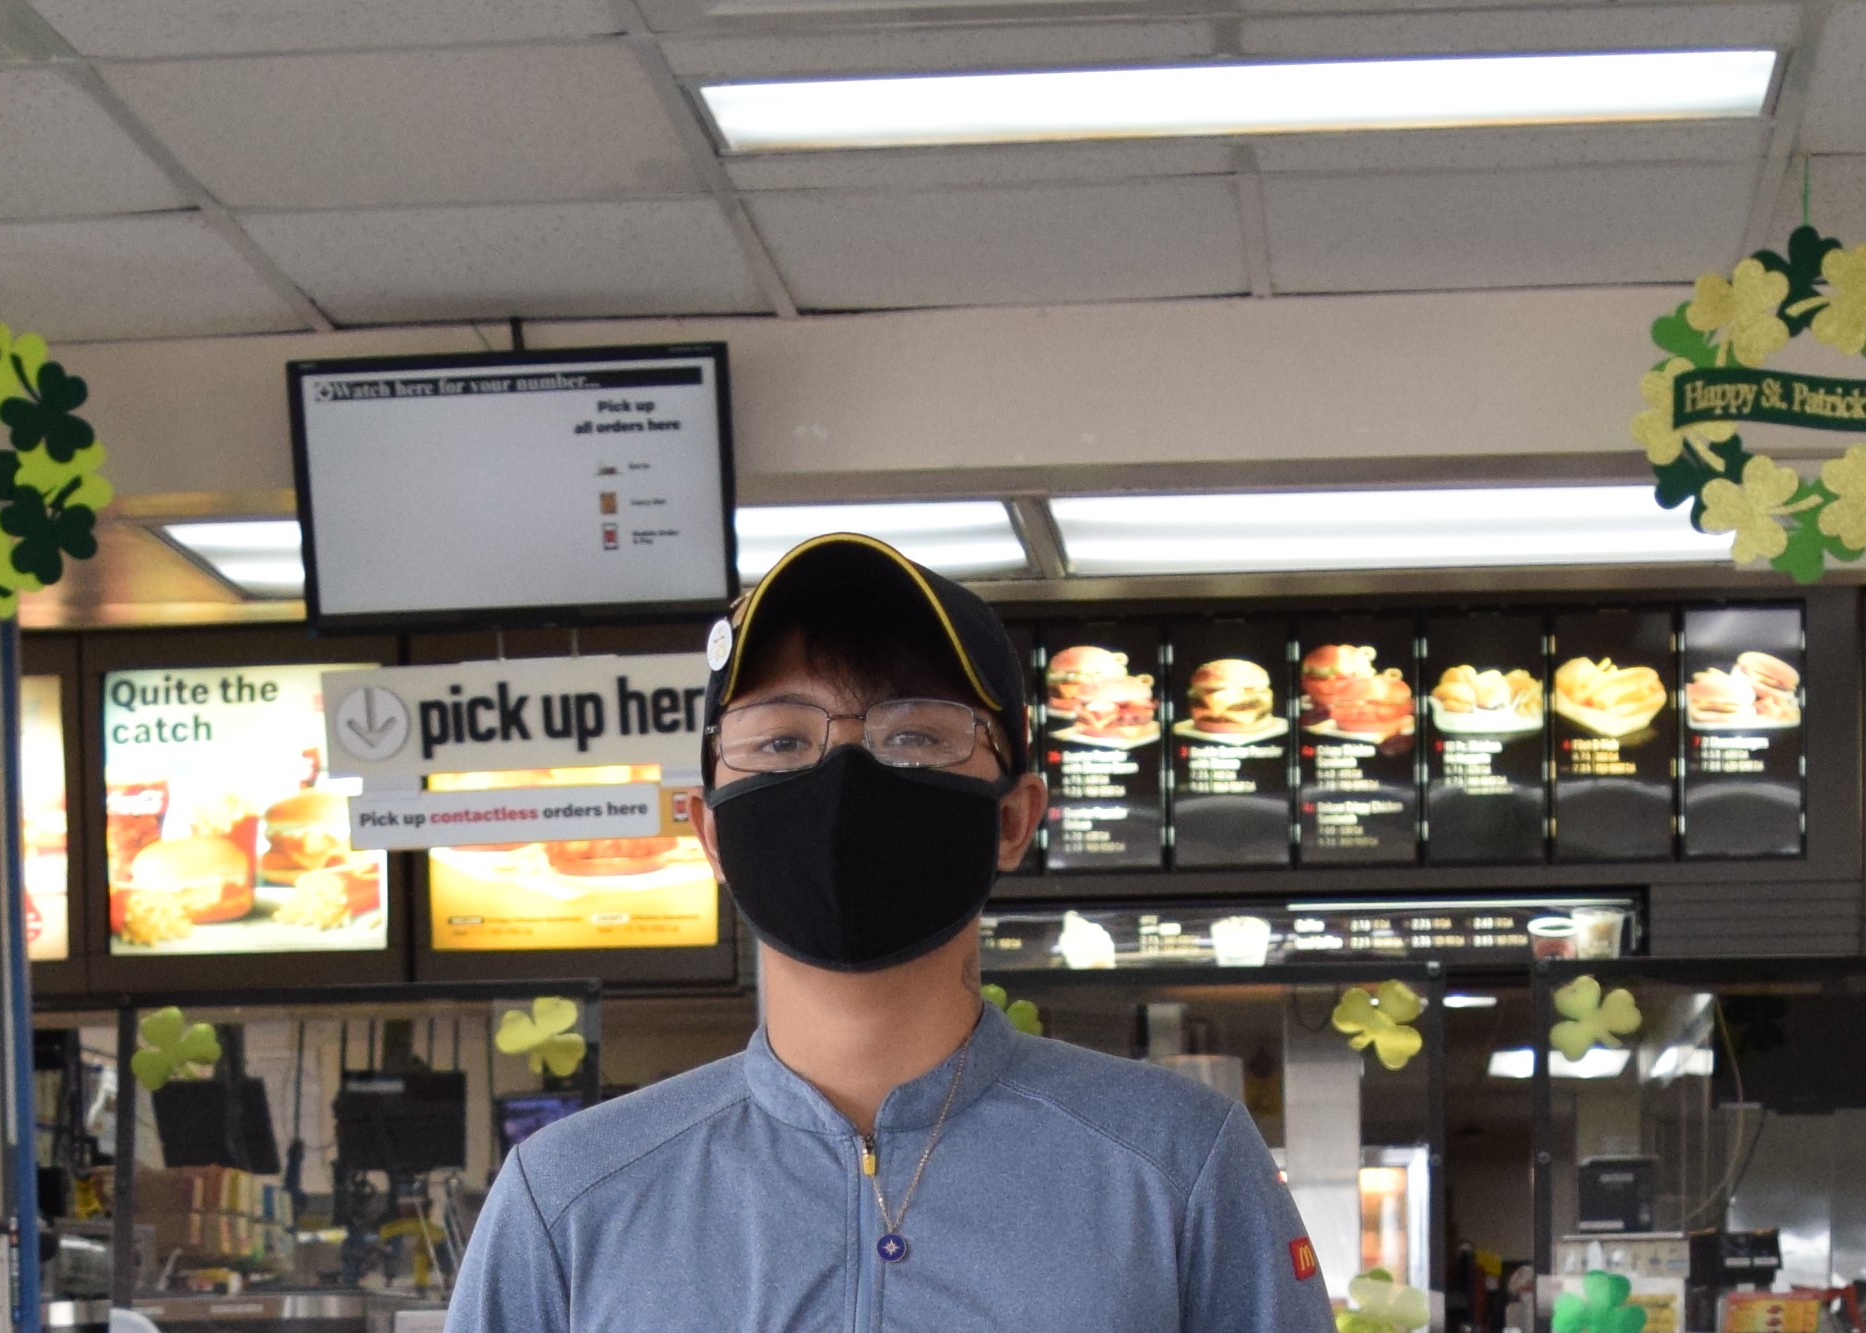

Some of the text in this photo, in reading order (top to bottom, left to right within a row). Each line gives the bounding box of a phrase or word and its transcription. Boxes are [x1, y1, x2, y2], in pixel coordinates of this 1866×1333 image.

[333, 372, 600, 399] Watch here for your number...
[1684, 379, 1758, 415] Happy
[1761, 378, 1788, 410] St.
[597, 399, 655, 413] Pick up
[574, 417, 681, 434] all orders here
[111, 673, 279, 713] Quite the
[112, 713, 213, 745] catch
[418, 674, 706, 760] pick up her
[359, 800, 649, 829] Pick up contactless orders here
